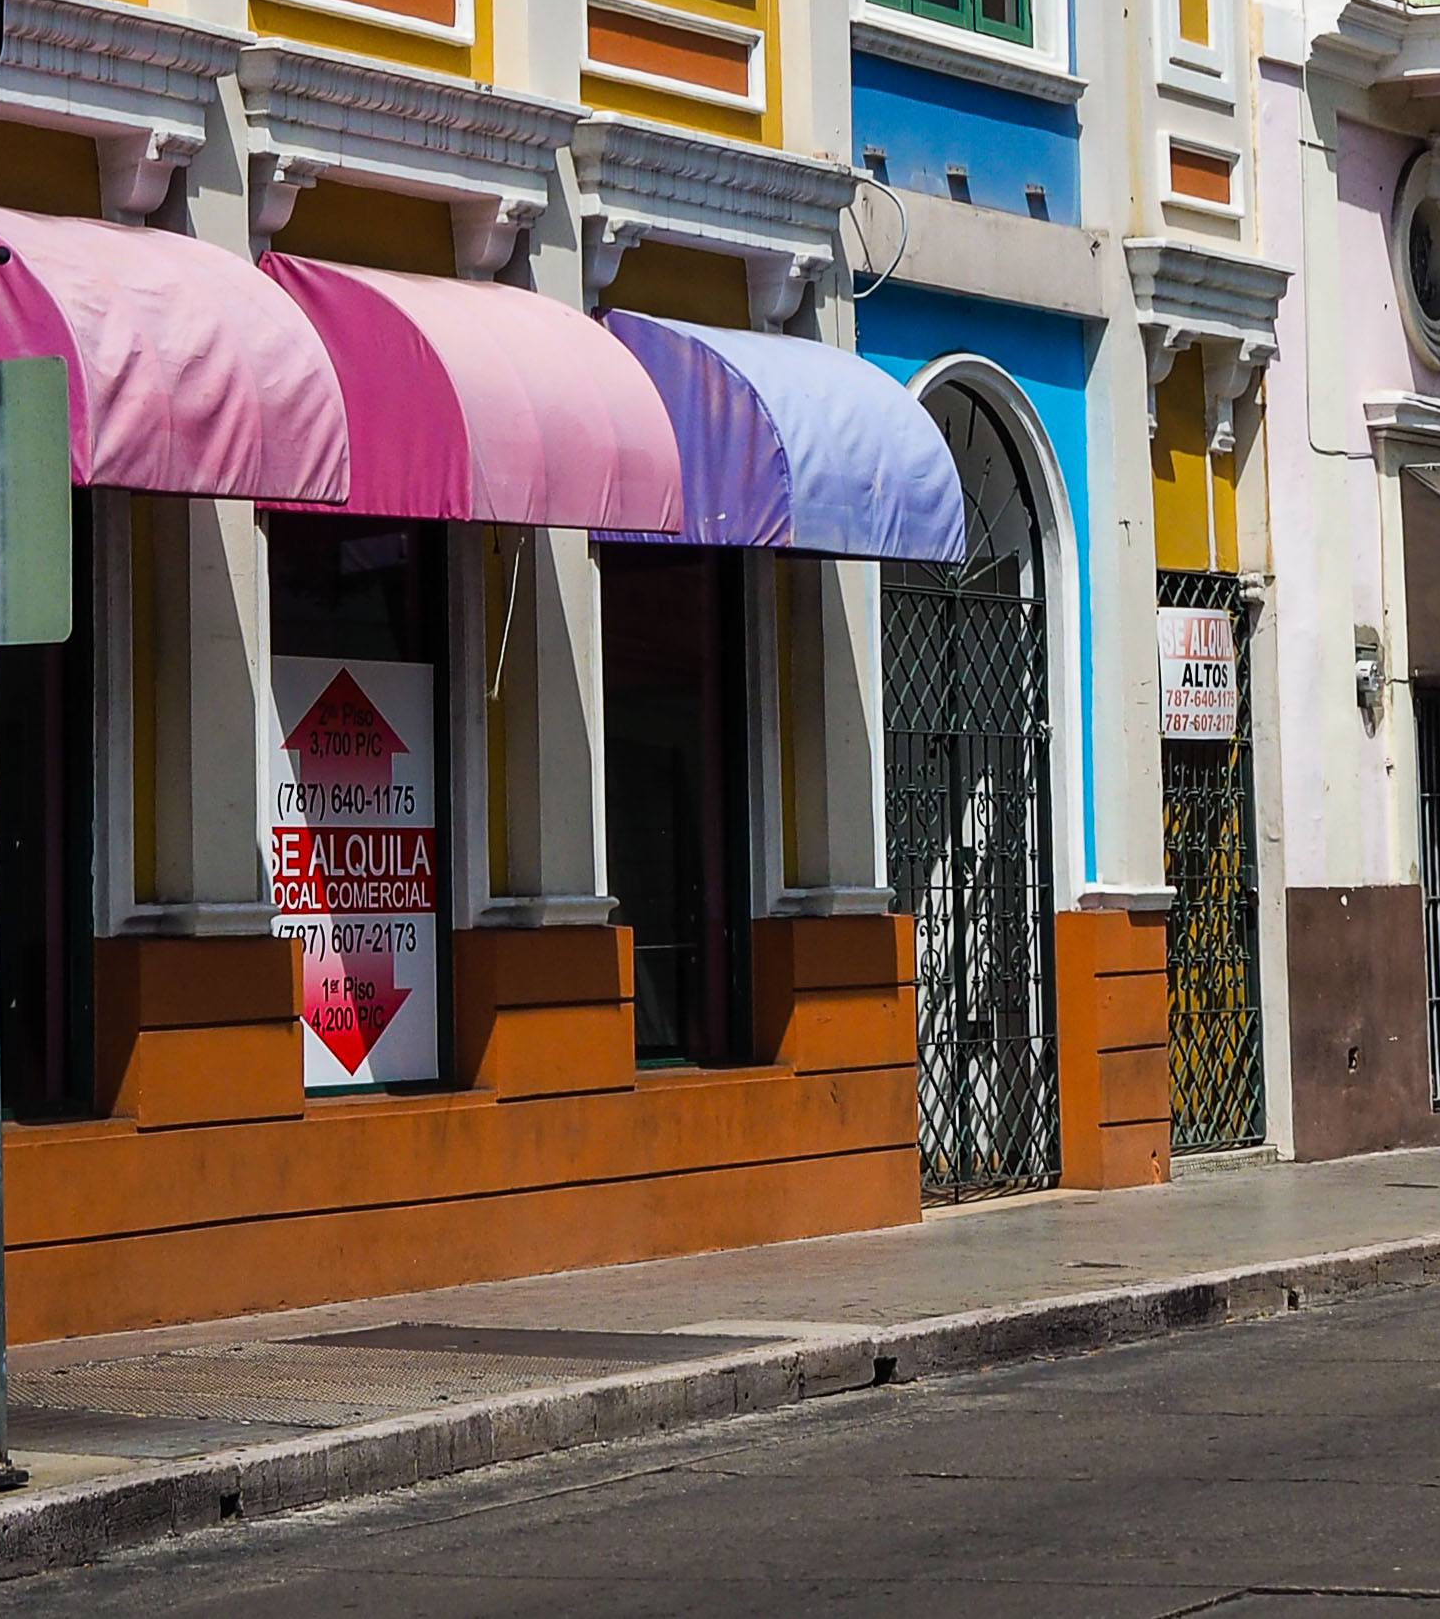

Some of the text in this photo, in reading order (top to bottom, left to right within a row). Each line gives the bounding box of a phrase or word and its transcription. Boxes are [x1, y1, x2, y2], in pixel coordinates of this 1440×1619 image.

[1163, 619, 1186, 657] SE
[1181, 663, 1228, 688] ALTOS
[1166, 690, 1235, 708] 787-640-1175
[343, 702, 374, 726] Piso
[1165, 714, 1235, 732] 787-607-2173
[310, 731, 382, 758] 3,700 P/C
[277, 782, 415, 820] (787) 640-1175
[308, 833, 432, 878] ALQUILA
[272, 881, 432, 909] OCAL COMERCIAL
[331, 922, 417, 954] 607-2173
[343, 977, 376, 1002] Piso
[311, 1005, 385, 1036] 4,200 P/C
